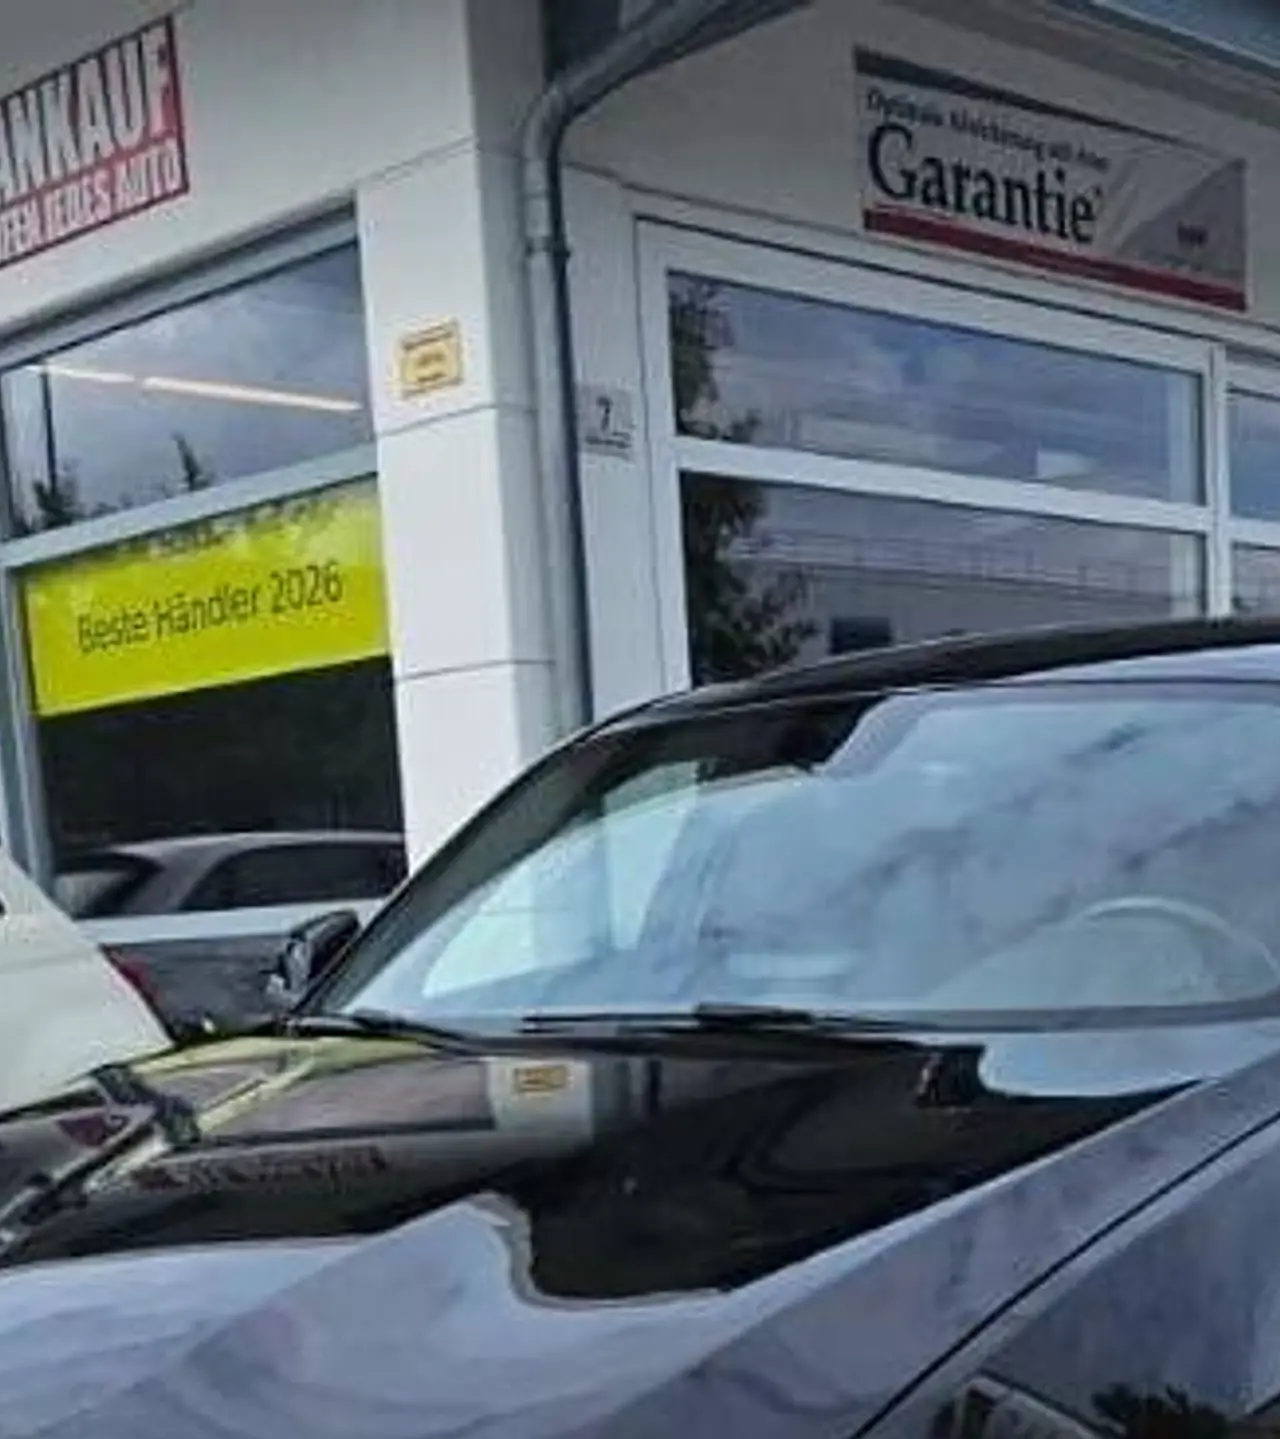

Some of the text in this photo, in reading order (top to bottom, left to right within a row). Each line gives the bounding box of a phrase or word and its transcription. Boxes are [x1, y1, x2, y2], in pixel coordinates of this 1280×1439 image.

[44, 168, 114, 240] JEDES
[115, 138, 181, 216] AUTO
[868, 122, 1096, 243] Garantie
[77, 562, 343, 653] Beste Händler 2026
